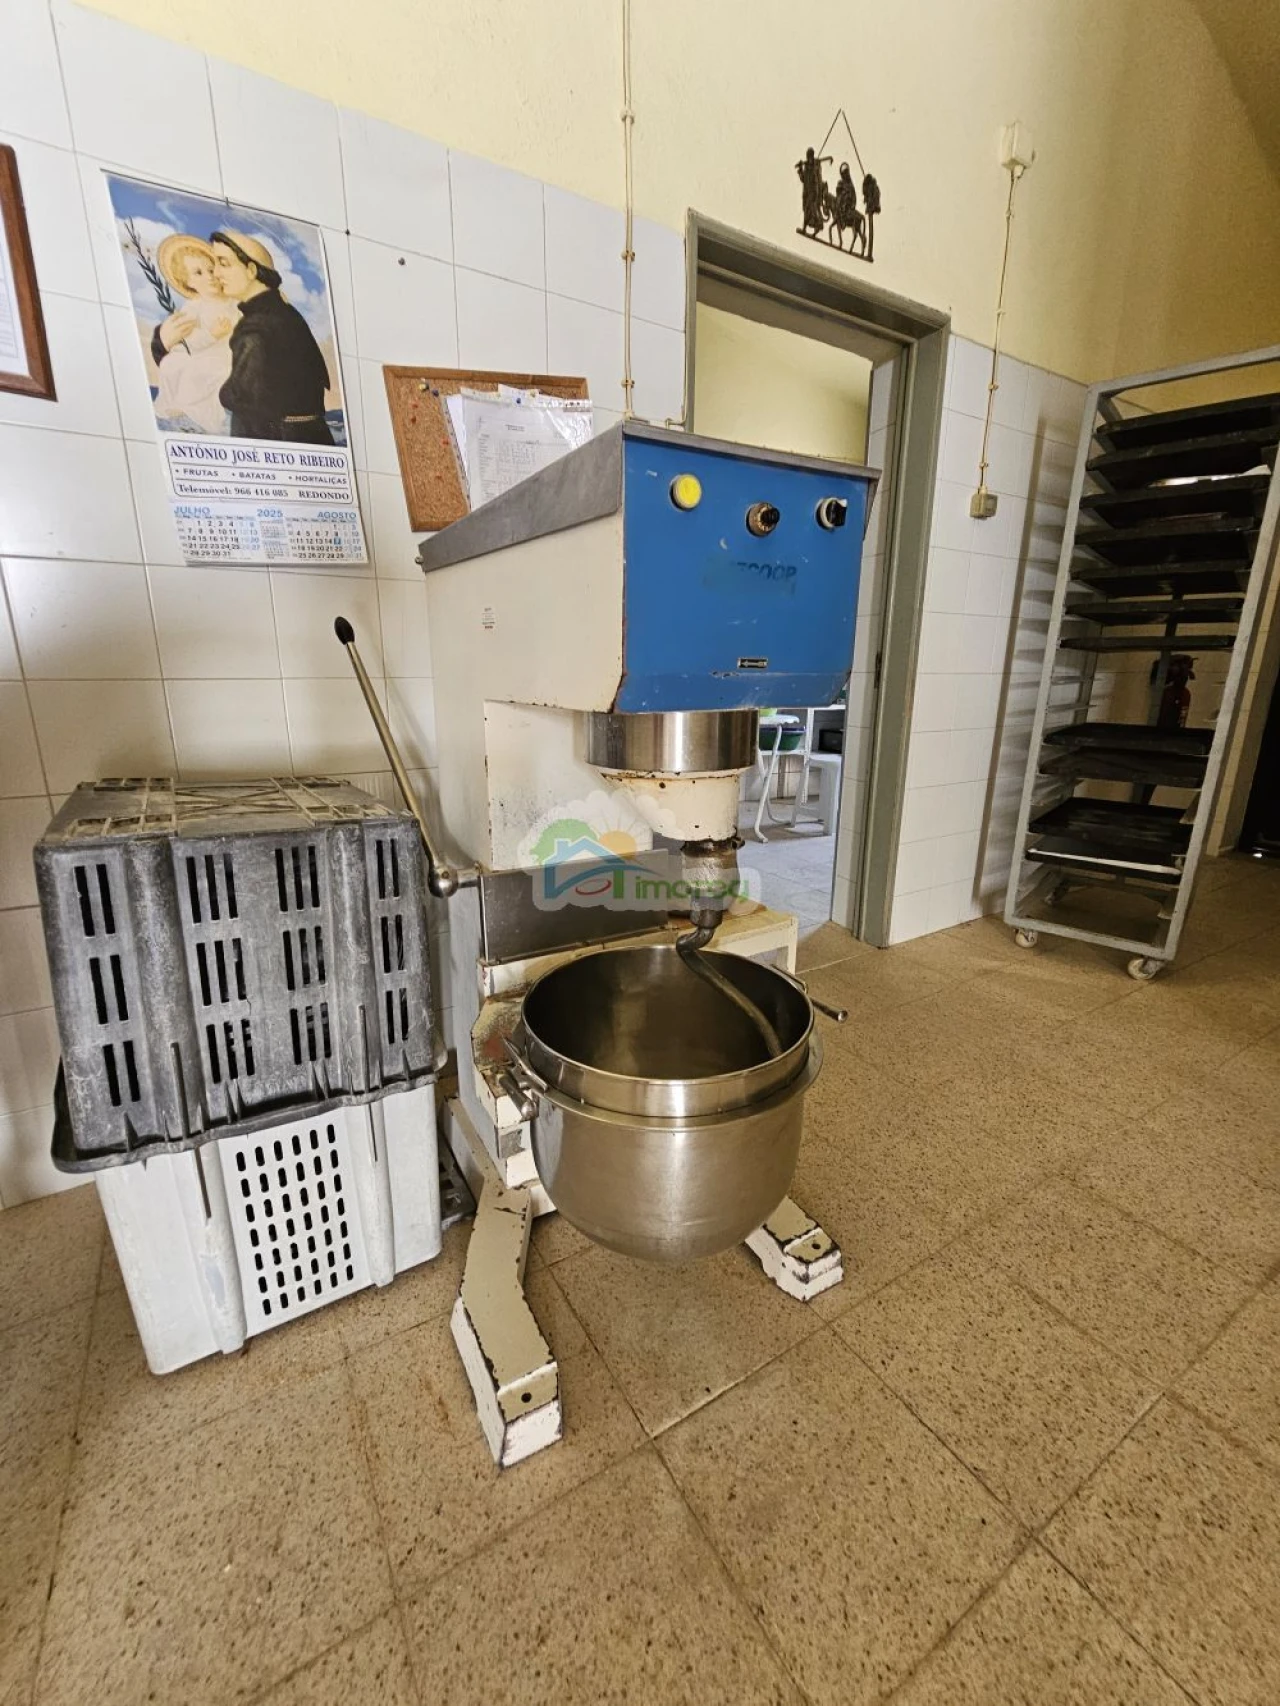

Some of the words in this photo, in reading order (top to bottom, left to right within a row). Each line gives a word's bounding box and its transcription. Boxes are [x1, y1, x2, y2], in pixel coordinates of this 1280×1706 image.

[170, 443, 227, 460] ANTÓNIO
[232, 447, 260, 463] JOSÉ
[264, 452, 295, 464] RETO
[299, 455, 344, 468] RIBEIRO
[183, 468, 219, 476] FRUTAS
[239, 472, 276, 480] BATATAS
[295, 475, 347, 484] HORTALIÇAS
[177, 484, 232, 495] Telemóvel:
[299, 490, 349, 499] REDONDO
[174, 506, 210, 516] JULHO
[257, 508, 283, 517] 2025
[317, 511, 357, 519] AGOSTO
